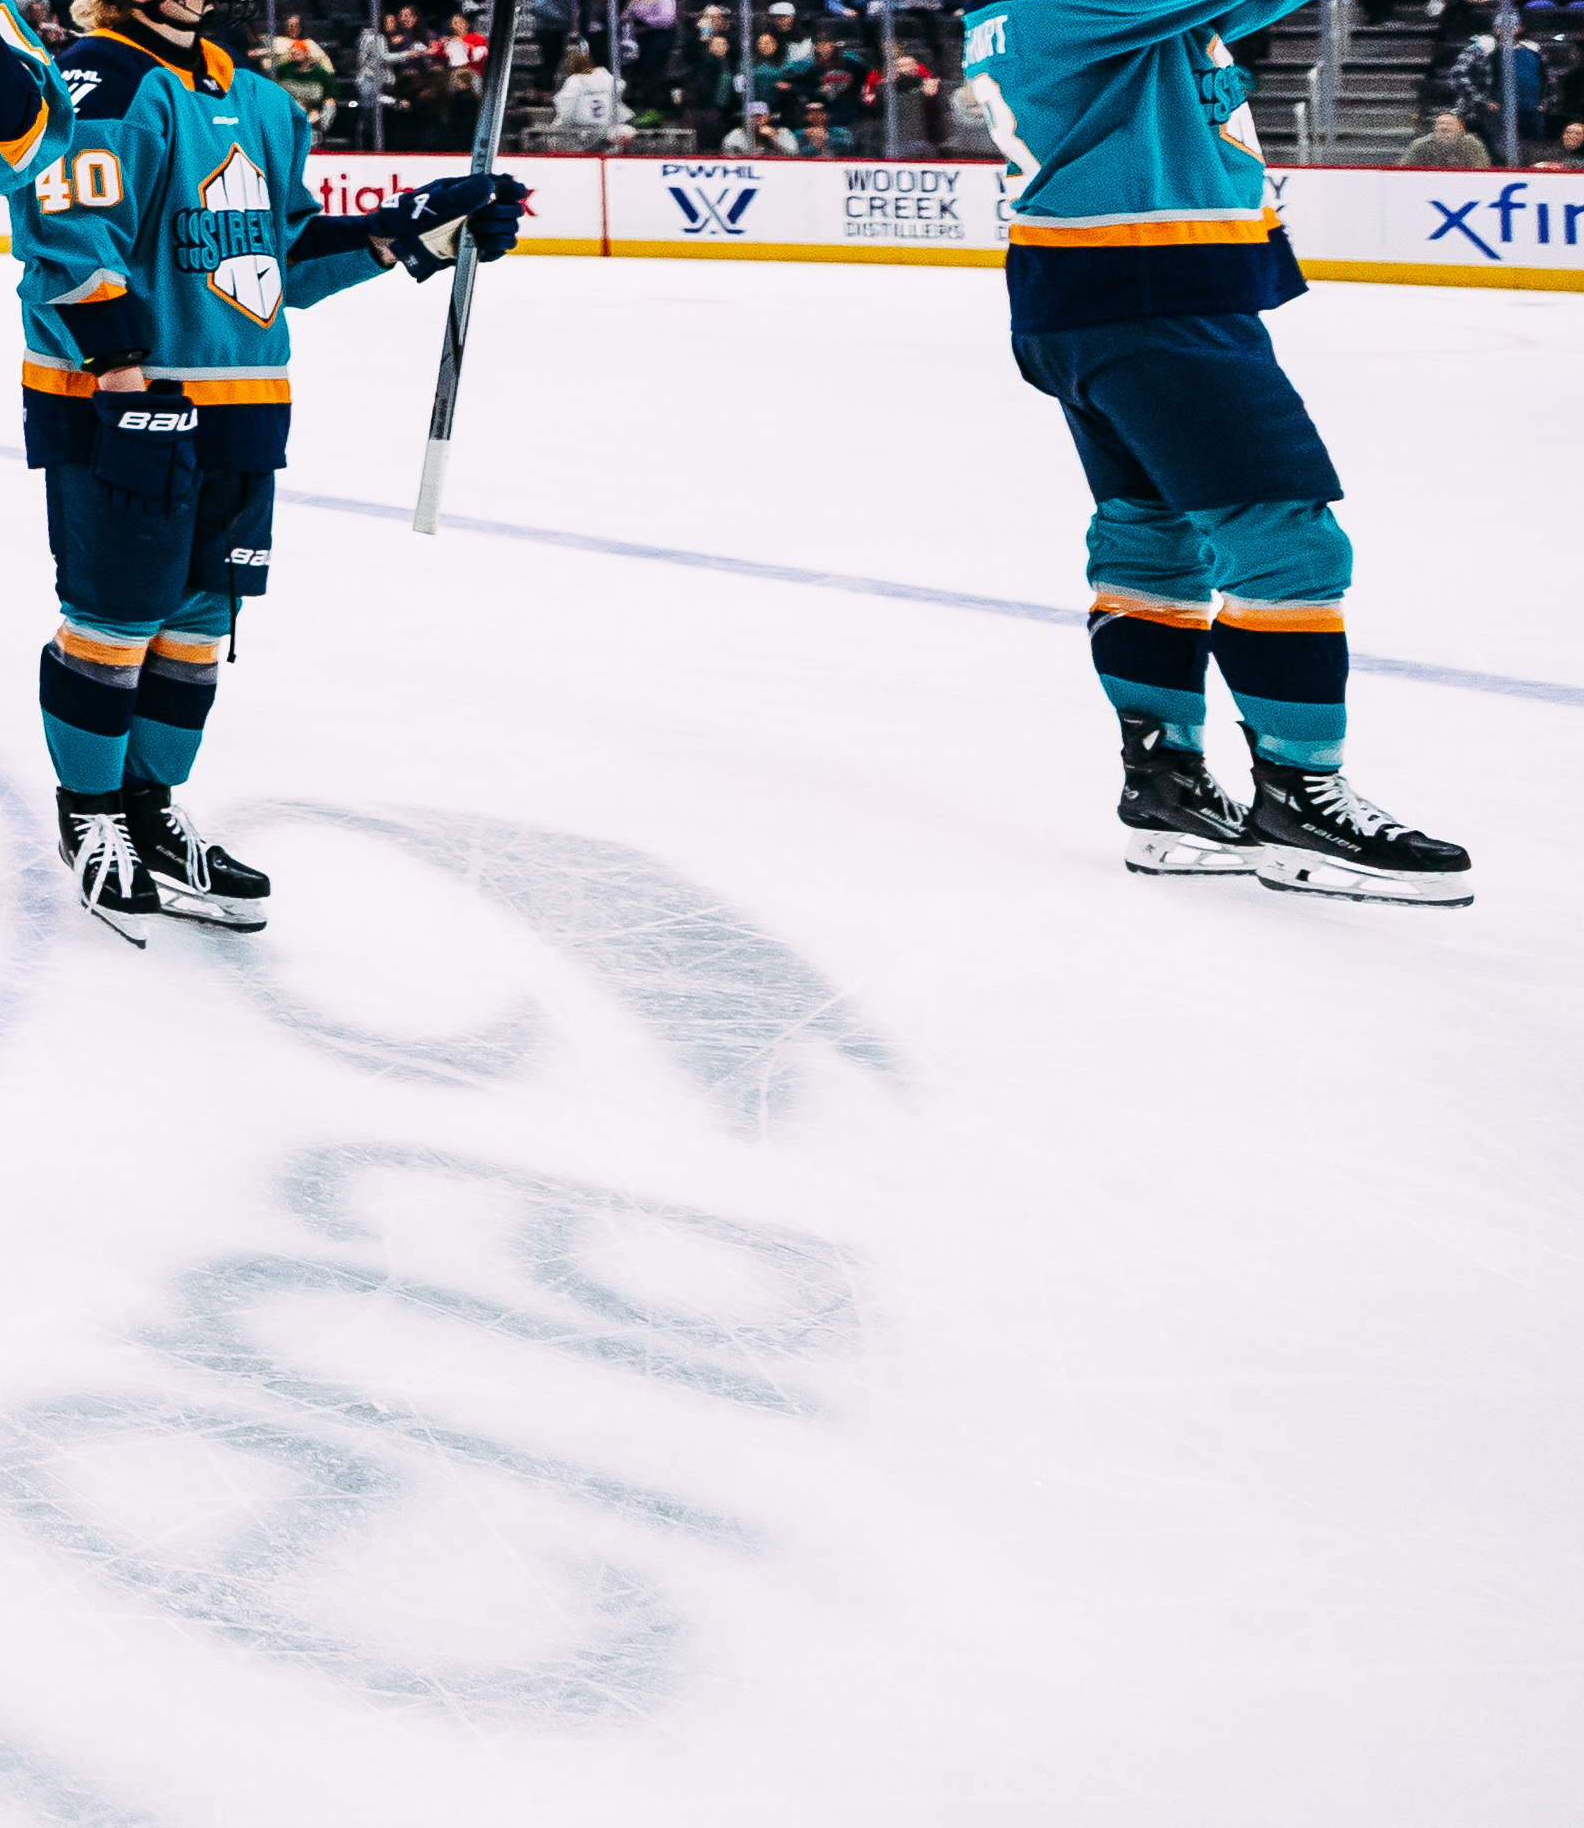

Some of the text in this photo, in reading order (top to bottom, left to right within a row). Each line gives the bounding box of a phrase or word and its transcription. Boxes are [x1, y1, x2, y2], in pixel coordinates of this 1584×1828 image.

[35, 148, 124, 214] 40
[844, 169, 961, 193] WOODY
[845, 195, 961, 221] CREEK
